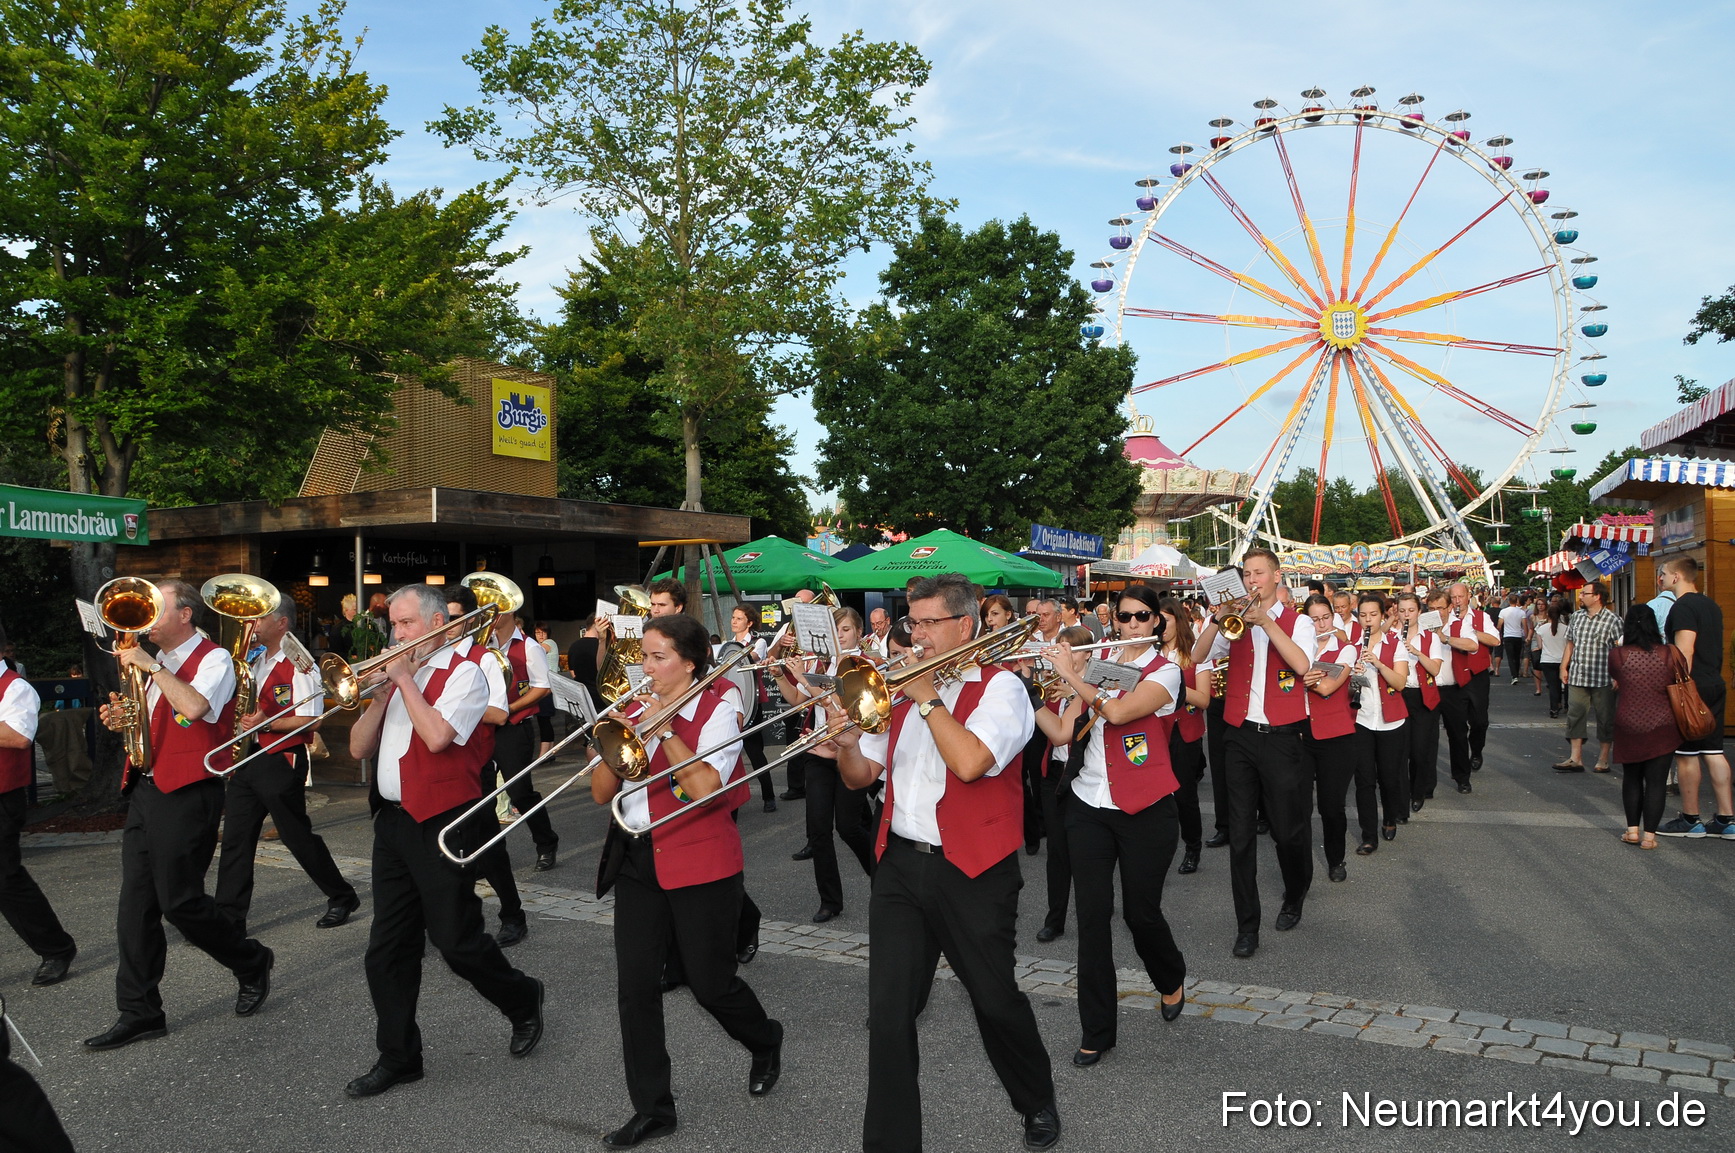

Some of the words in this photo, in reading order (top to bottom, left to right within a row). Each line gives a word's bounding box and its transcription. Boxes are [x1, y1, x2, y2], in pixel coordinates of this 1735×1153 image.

[498, 399, 547, 434] Burgis
[498, 435, 518, 445] Weil's
[519, 439, 537, 449] guad
[9, 501, 118, 537] Lammsbräu
[1042, 528, 1069, 551] Original
[1068, 532, 1096, 553] Backfisch
[1600, 552, 1623, 568] GYROS
[1608, 559, 1626, 571] PITA
